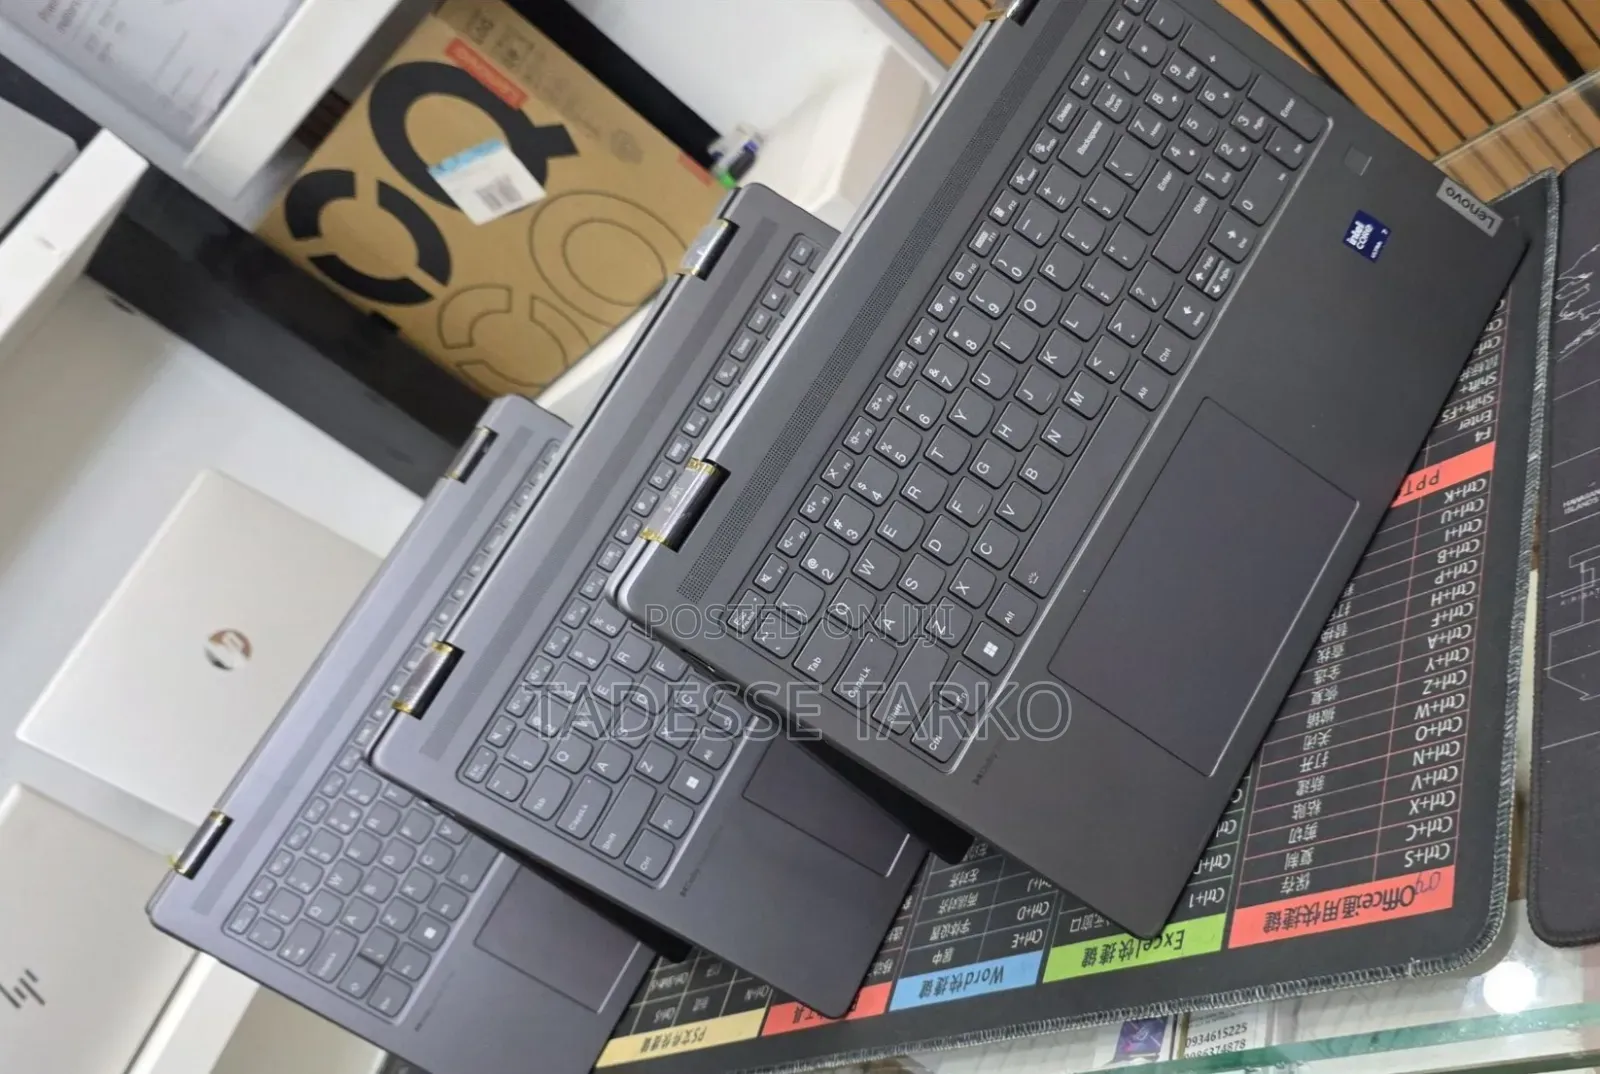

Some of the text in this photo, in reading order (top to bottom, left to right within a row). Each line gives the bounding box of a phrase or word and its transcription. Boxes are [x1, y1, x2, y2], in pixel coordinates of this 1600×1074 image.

[1076, 120, 1103, 156] Backspace
[1157, 170, 1172, 192] Enter
[1193, 196, 1209, 214] Shift
[1445, 186, 1496, 230] Lenovo
[1346, 220, 1365, 246] intel
[1159, 348, 1172, 362] Ctrl
[1138, 387, 1149, 399] Alt
[1441, 390, 1495, 424] Shift+F5
[1457, 409, 1492, 431] Enter
[1474, 426, 1492, 443] F4
[1401, 469, 1440, 496] PPT
[1444, 478, 1486, 504] Ctrl+K
[1440, 499, 1484, 524] Ctrl+U
[1445, 518, 1483, 542] Ctrl+I
[1438, 539, 1480, 564] Ctrl+B
[1434, 560, 1478, 584] Ctrl+P
[1430, 581, 1476, 606] Ctrl+H
[1004, 611, 1016, 624] Alt
[1430, 602, 1474, 628] Ctrl+F
[1428, 624, 1472, 648] Ctrl+A
[807, 656, 822, 673] Tab
[1424, 646, 1470, 672] Ctrl+Y
[848, 666, 872, 698] CapsLk
[1314, 664, 1342, 685] 全选
[1422, 670, 1468, 696] Ctrl+Z
[1414, 694, 1466, 720] Ctrl+W
[1303, 728, 1332, 750] 关闭
[1415, 716, 1463, 742] Ctrl+O
[928, 734, 943, 752] Ctrl
[1412, 740, 1460, 766] Ctrl+N
[1300, 750, 1330, 773] 打开
[1296, 774, 1325, 796] 新建
[1410, 766, 1458, 792] Ctrl+V
[1292, 798, 1322, 821] 粘贴
[1408, 790, 1456, 816] Ctrl+X
[1288, 821, 1319, 845] 剪切
[1405, 816, 1453, 842] Ctrl+C
[1284, 846, 1315, 870] 复制
[1404, 842, 1450, 868] Ctrl+S
[1280, 872, 1311, 895] 保存
[1188, 886, 1226, 909] Ctrl+1
[1262, 884, 1415, 934] Office通用快捷键
[1017, 901, 1050, 920] Ctrl+D
[929, 919, 972, 942] 字体设置
[1011, 928, 1043, 949] Ctrl+E
[932, 947, 956, 966] 居中
[918, 965, 1004, 998] Word快捷键
[1185, 1022, 1248, 1048] 0934615225
